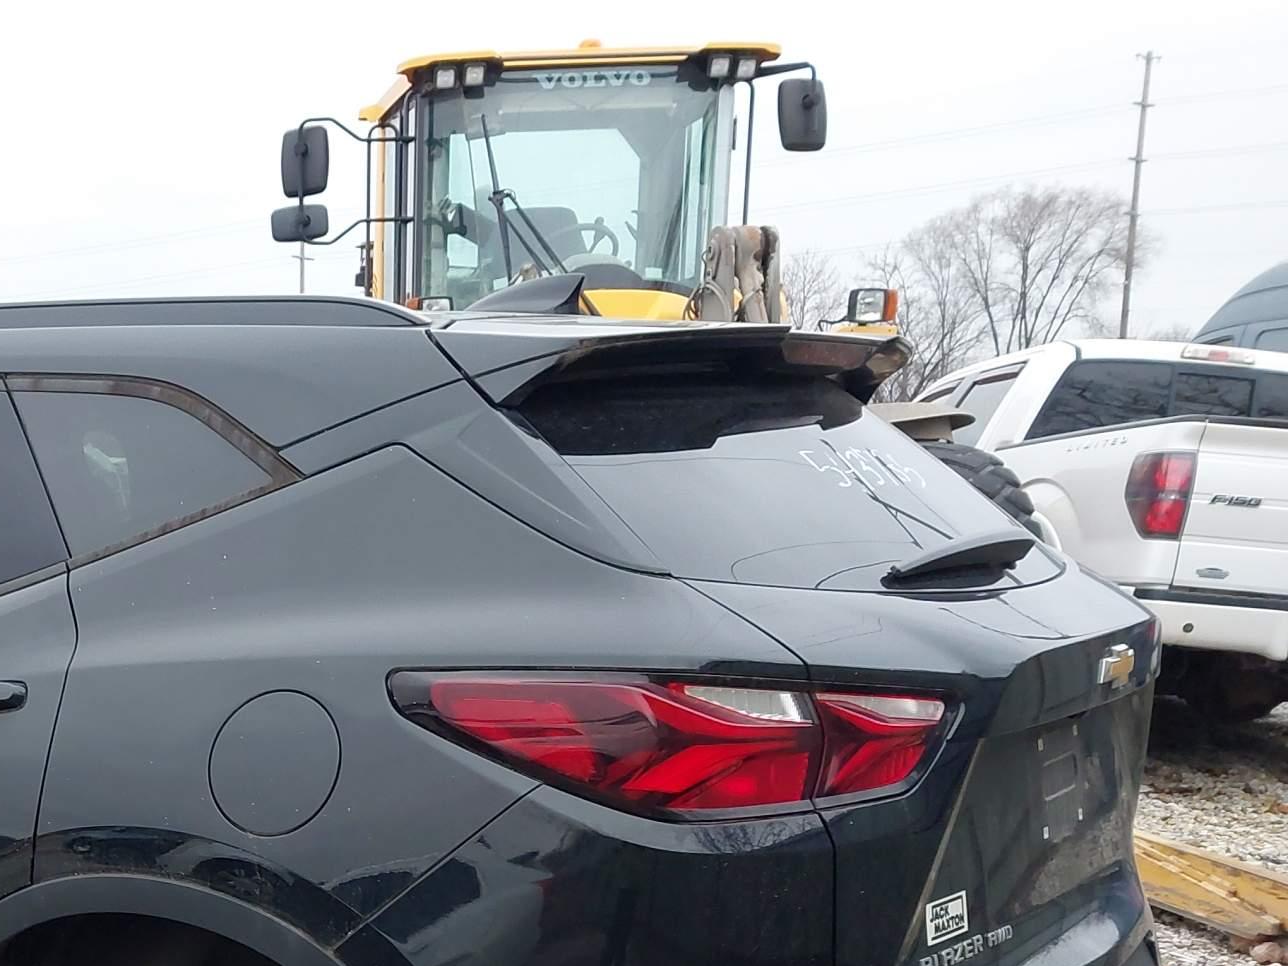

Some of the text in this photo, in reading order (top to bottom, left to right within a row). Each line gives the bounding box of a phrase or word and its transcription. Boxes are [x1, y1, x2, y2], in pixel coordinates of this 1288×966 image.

[532, 70, 651, 90] VOLVO
[930, 905, 950, 923] JACK
[934, 913, 965, 935] MAXTON
